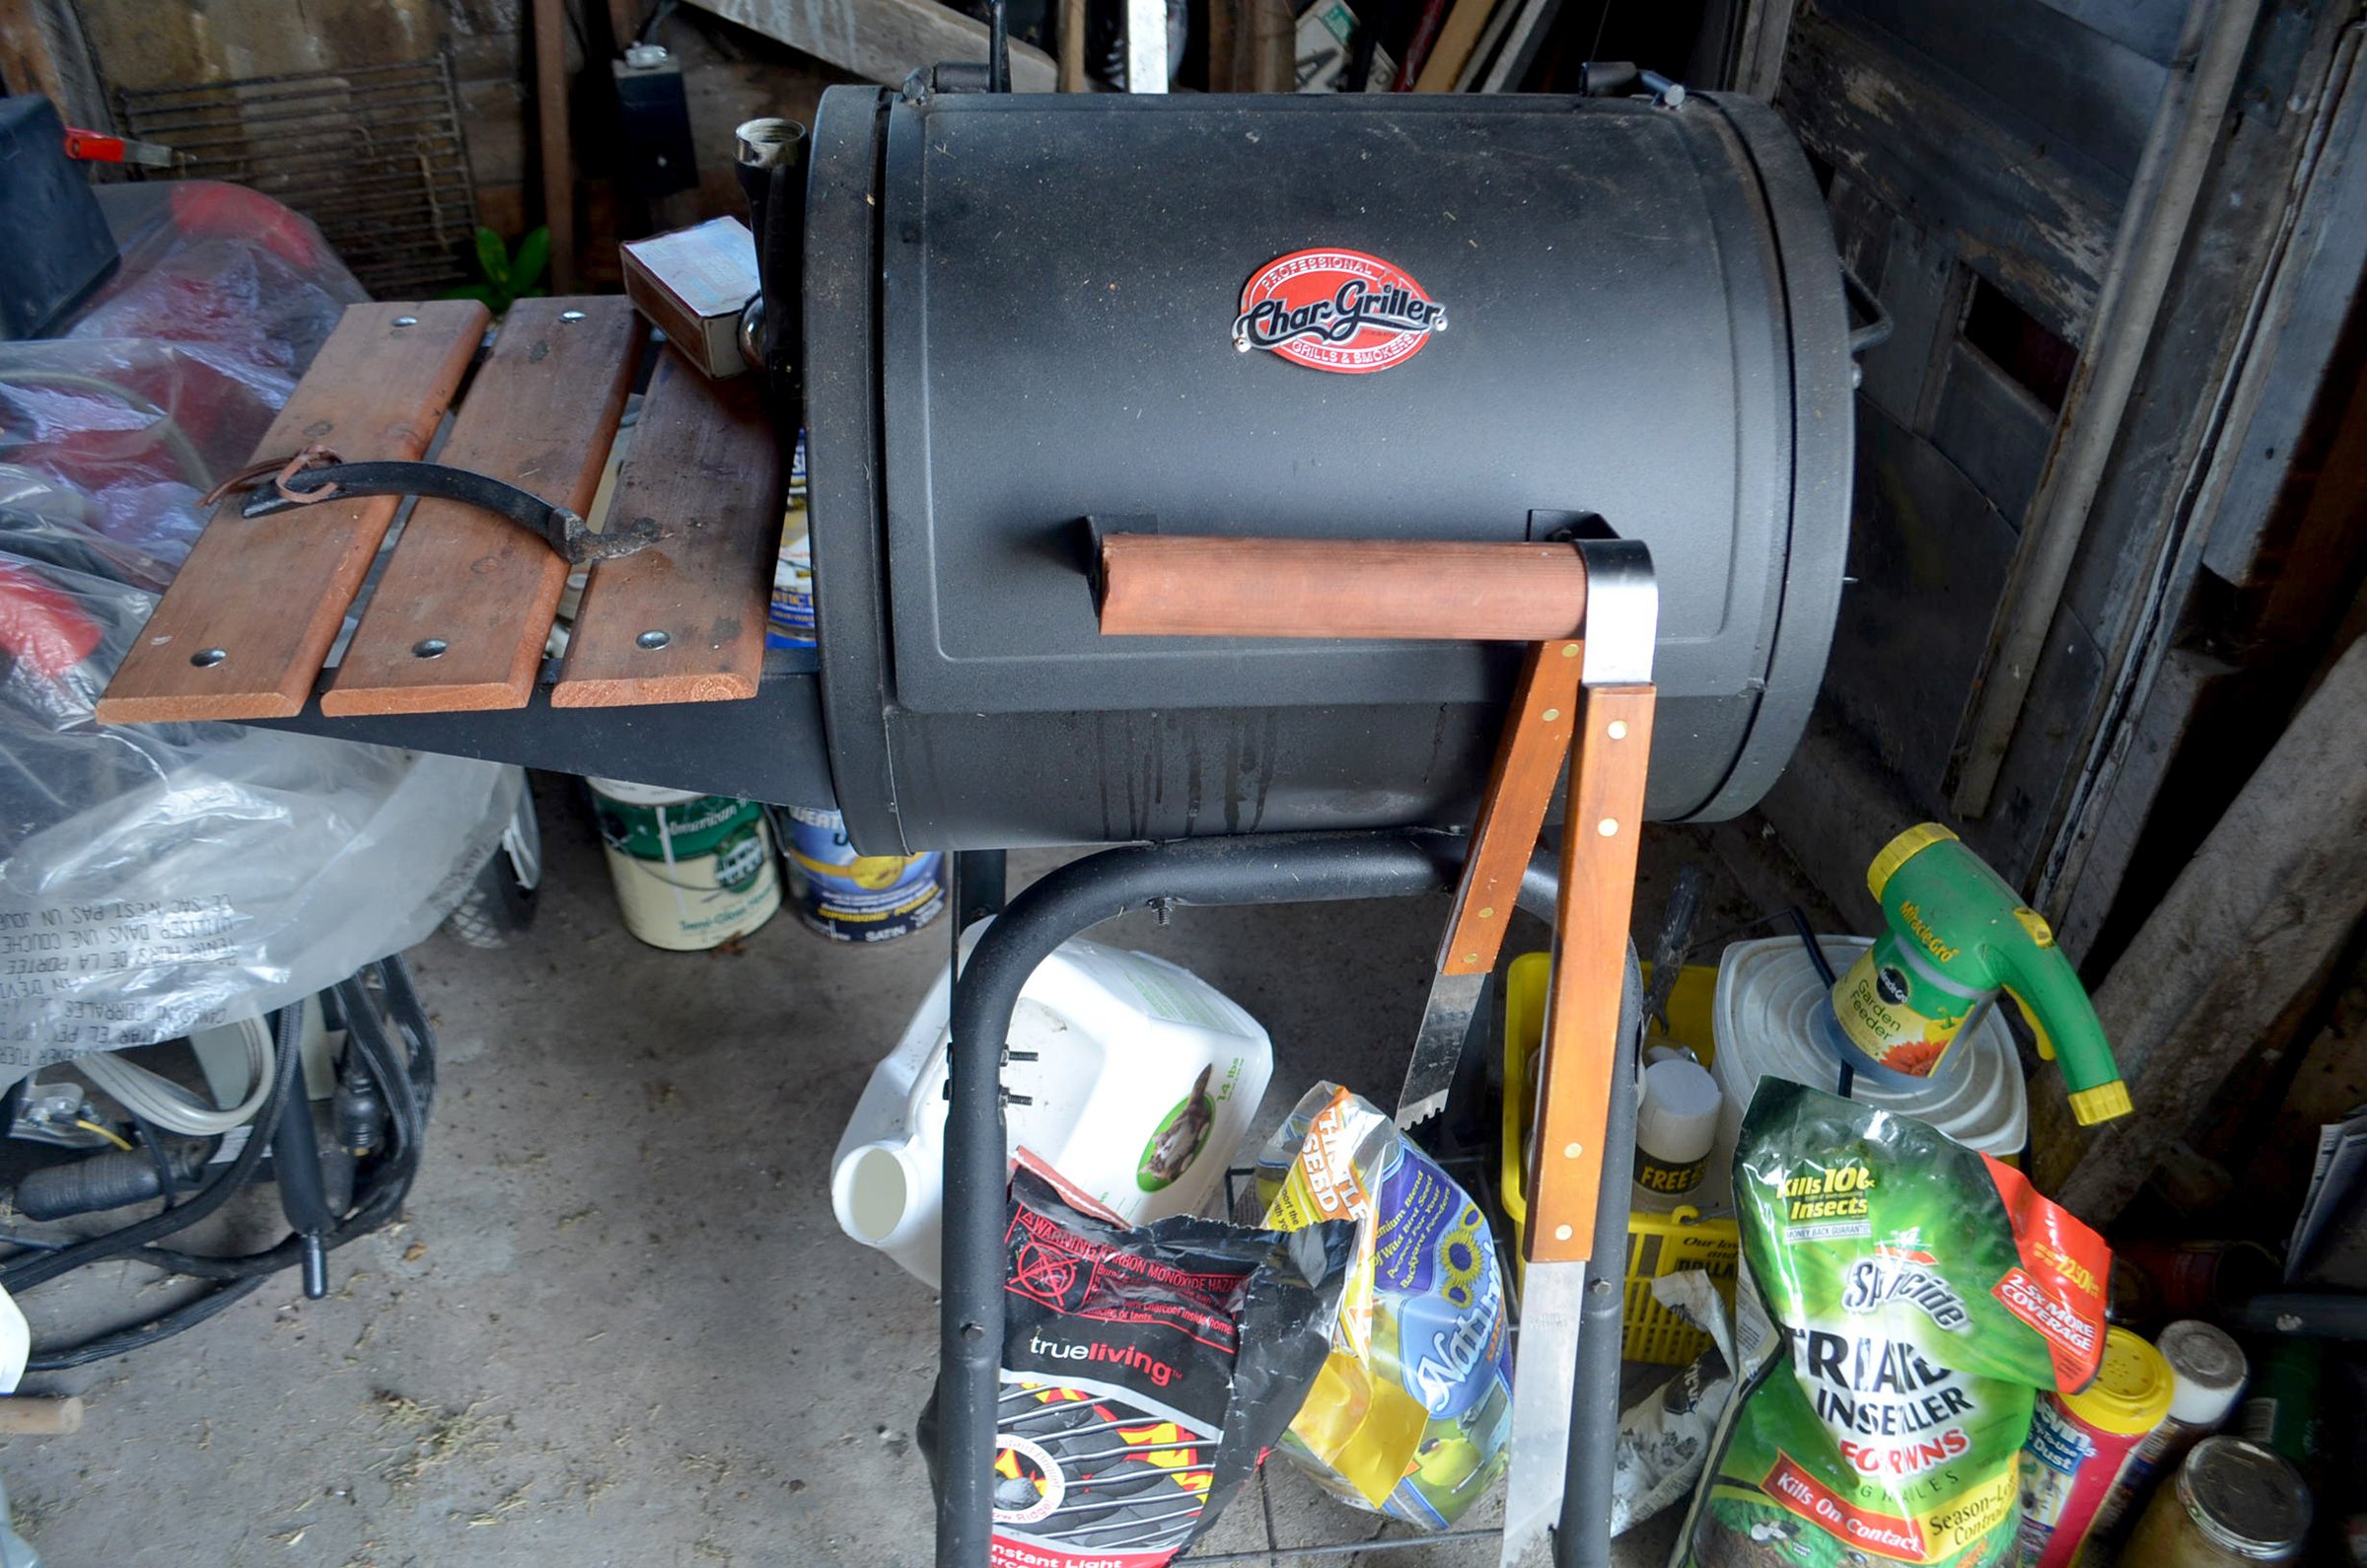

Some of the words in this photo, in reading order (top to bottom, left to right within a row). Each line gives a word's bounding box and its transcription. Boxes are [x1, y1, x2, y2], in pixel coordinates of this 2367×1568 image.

[1261, 256, 1373, 291] PROFESSIONAL
[1291, 338, 1338, 363] GRILLS
[1340, 350, 1351, 365] &
[1353, 332, 1416, 366] SMOKERS
[0, 911, 32, 931] JOUE
[41, 909, 64, 926] UN
[71, 905, 104, 925] PAS
[0, 933, 62, 955] COUCHE
[69, 930, 100, 948] UNE
[108, 925, 150, 944] DANS
[79, 954, 101, 972] LA
[108, 951, 129, 969] DE
[1850, 989, 1895, 1040] Feeder
[1857, 978, 1901, 1033] Garden
[1301, 1132, 1339, 1213] SEED
[1641, 1166, 1690, 1191] FREE
[1776, 1176, 1822, 1200] Kills
[1791, 1198, 1867, 1220] Insects
[1035, 1217, 1098, 1256] WARNING
[1379, 1232, 1405, 1258] Wild
[1684, 1237, 1713, 1248] Our
[1399, 1233, 1428, 1289] Backyard
[1147, 1264, 1205, 1290] MONOXIDE
[1207, 1276, 1235, 1294] HAZA
[2001, 1283, 2093, 1352] COVERAGE
[2044, 1301, 2095, 1338] MORE
[1030, 1334, 1173, 1388] trueliving
[2033, 1439, 2072, 1470] Dust
[1777, 1472, 1813, 1506] Kills
[1816, 1497, 1842, 1524] On
[1845, 1518, 1921, 1552] Contact
[992, 1543, 1061, 1568] nstant
